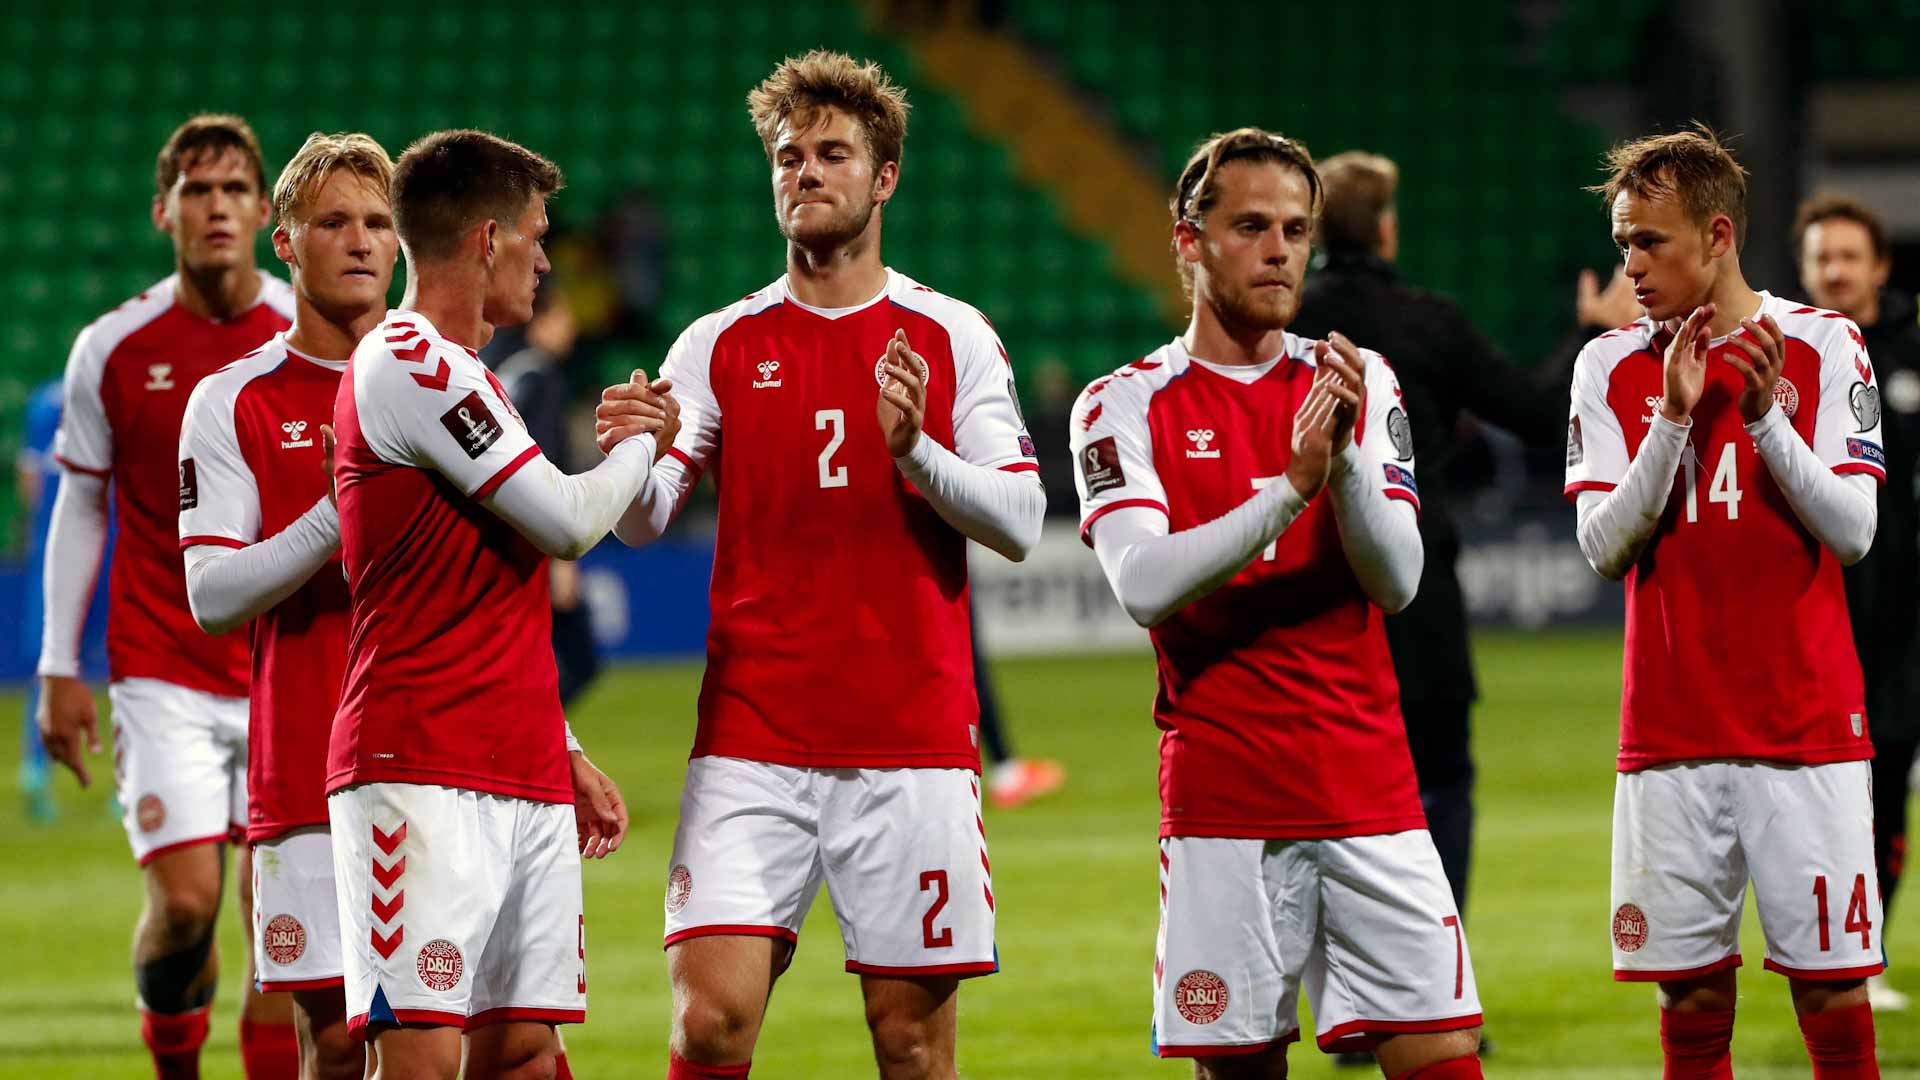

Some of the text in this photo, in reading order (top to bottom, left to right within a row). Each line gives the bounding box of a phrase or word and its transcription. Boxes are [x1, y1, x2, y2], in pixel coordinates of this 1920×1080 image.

[753, 379, 782, 389] hummel
[281, 438, 313, 449] hummel
[815, 408, 849, 489] 2
[1185, 448, 1221, 459] hummel
[1680, 442, 1743, 523] 14
[919, 869, 953, 949] 2
[1812, 873, 1872, 952] 14
[1620, 919, 1641, 936] DBU
[271, 931, 298, 947] DBU
[425, 957, 455, 974] DBU
[1441, 915, 1464, 1000] 7
[1185, 987, 1219, 1006] DBU
